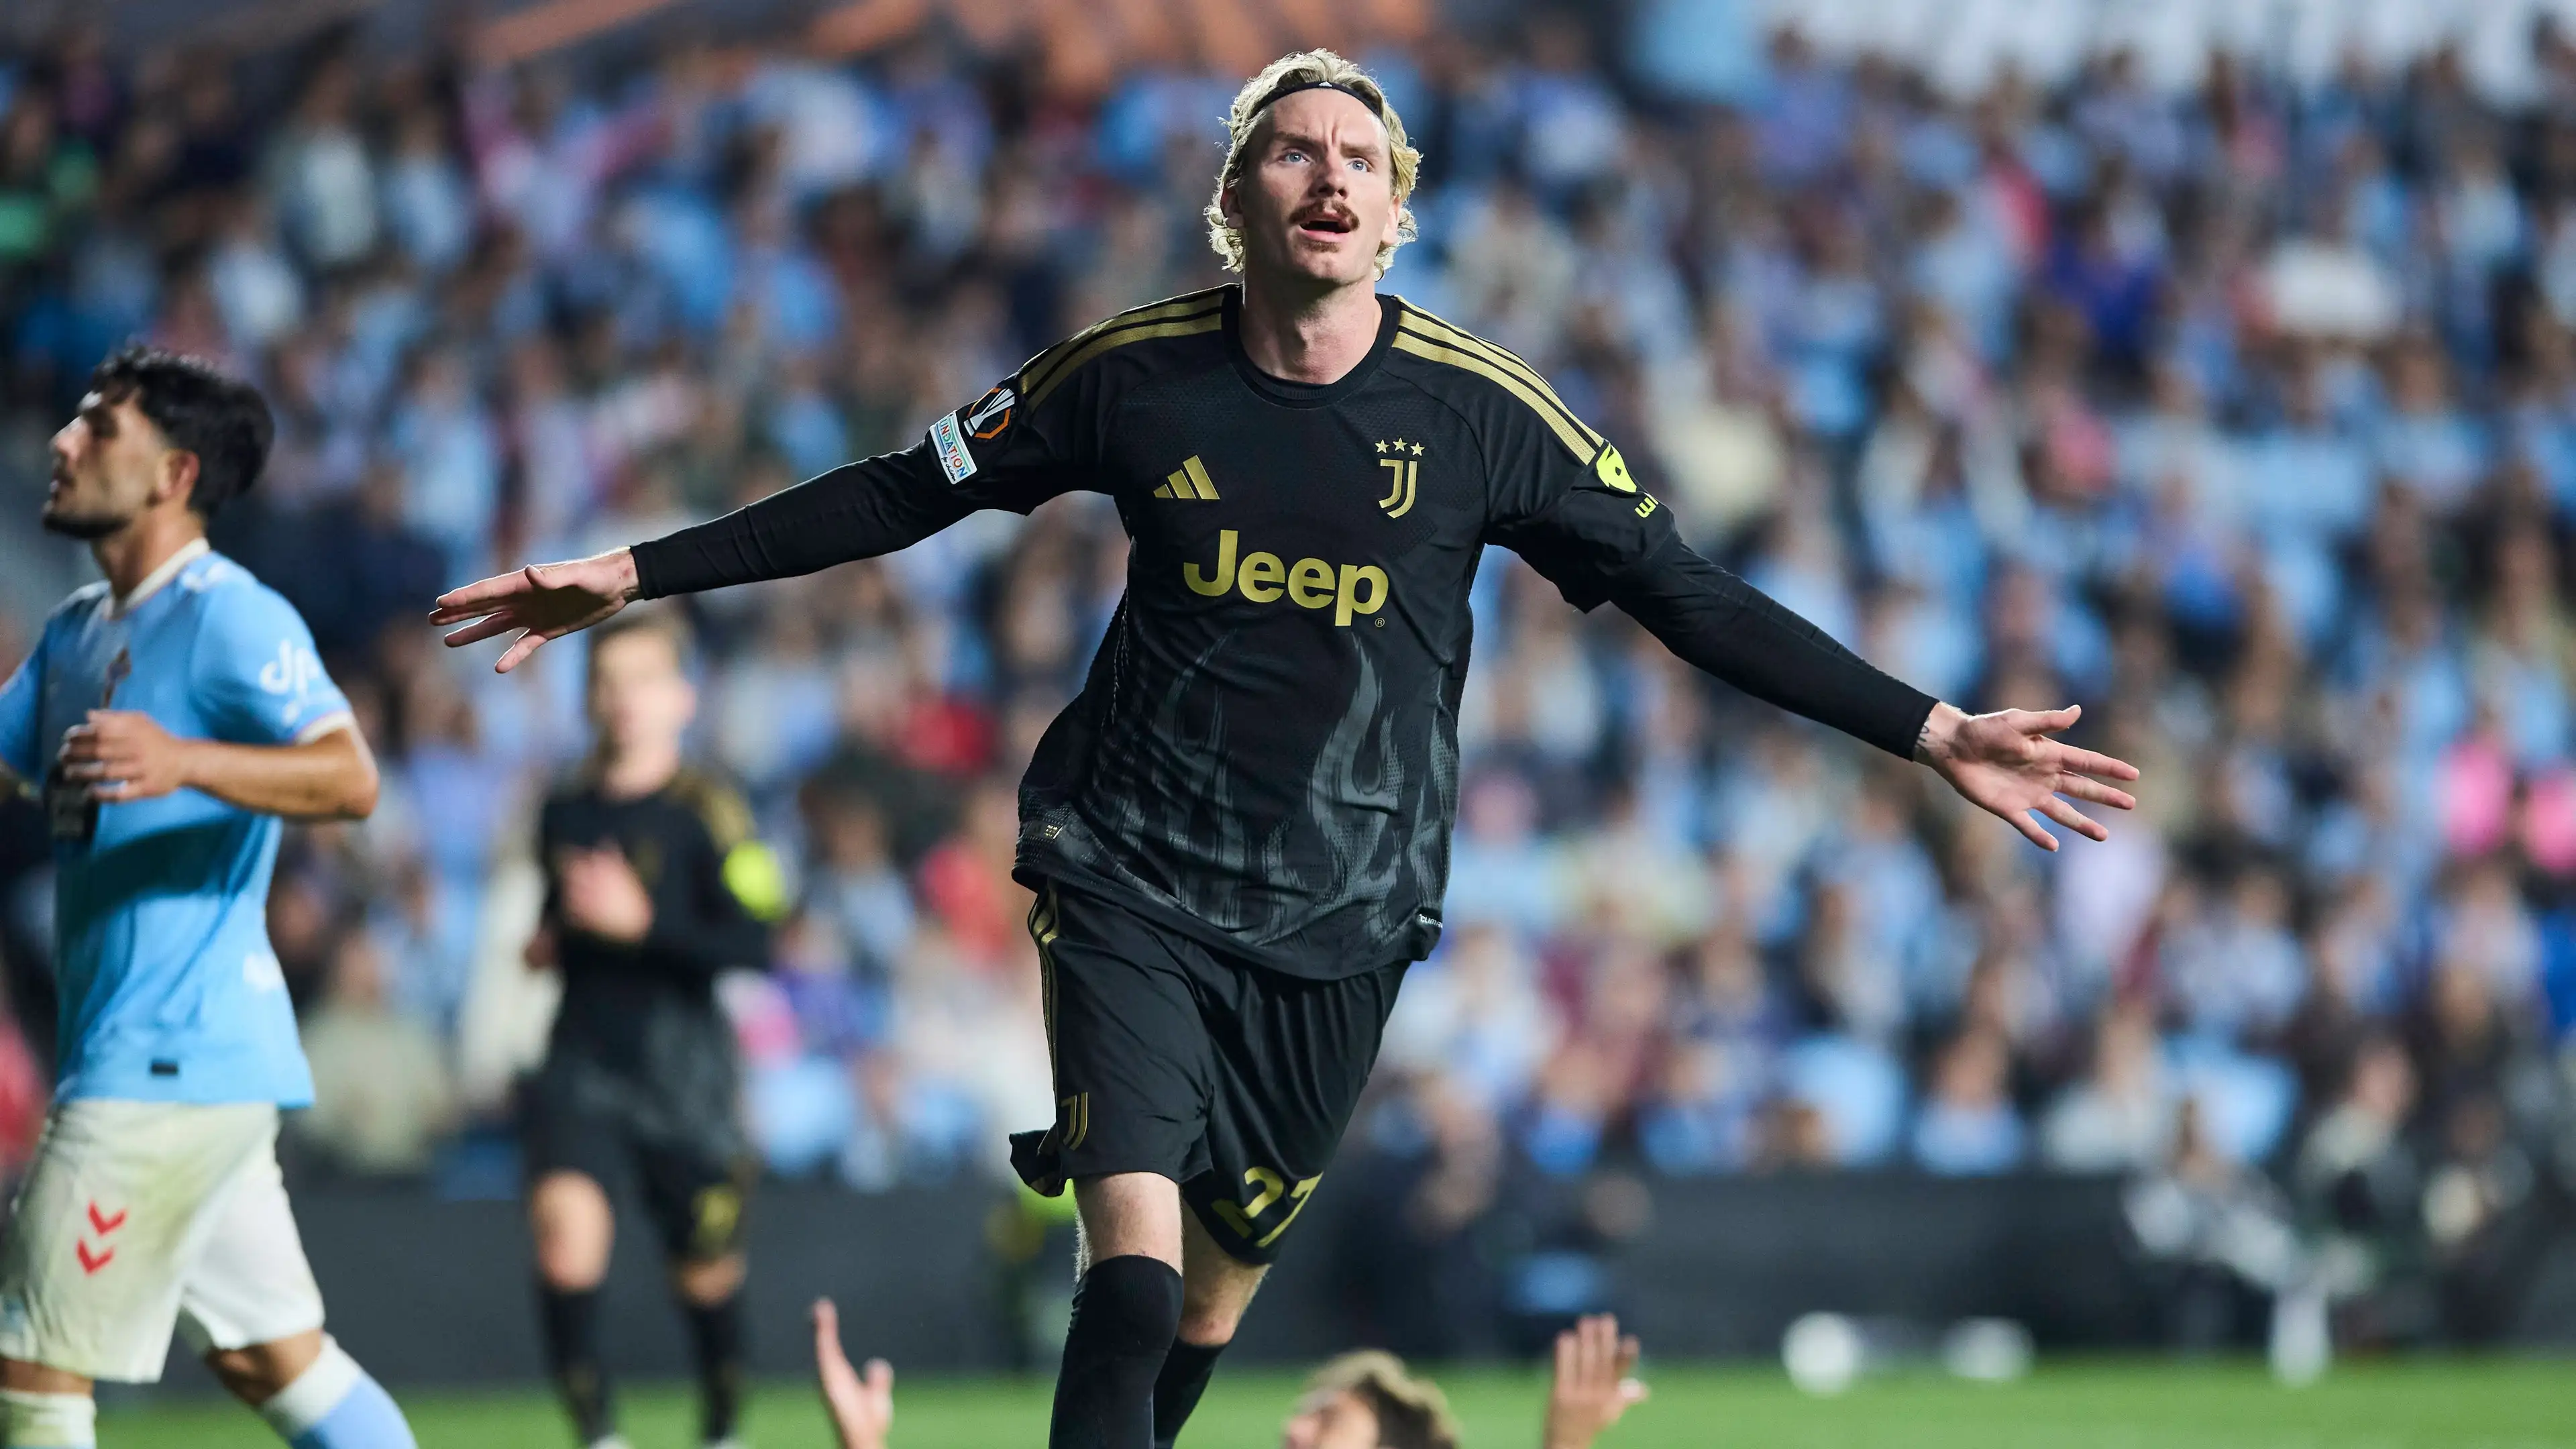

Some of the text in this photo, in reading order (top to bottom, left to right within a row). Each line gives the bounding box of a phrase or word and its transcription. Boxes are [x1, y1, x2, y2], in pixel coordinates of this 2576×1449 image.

[940, 418, 967, 477] UNDATION
[946, 464, 956, 481] children
[1183, 529, 1389, 626] Jeep
[1212, 1166, 1324, 1248] 27
